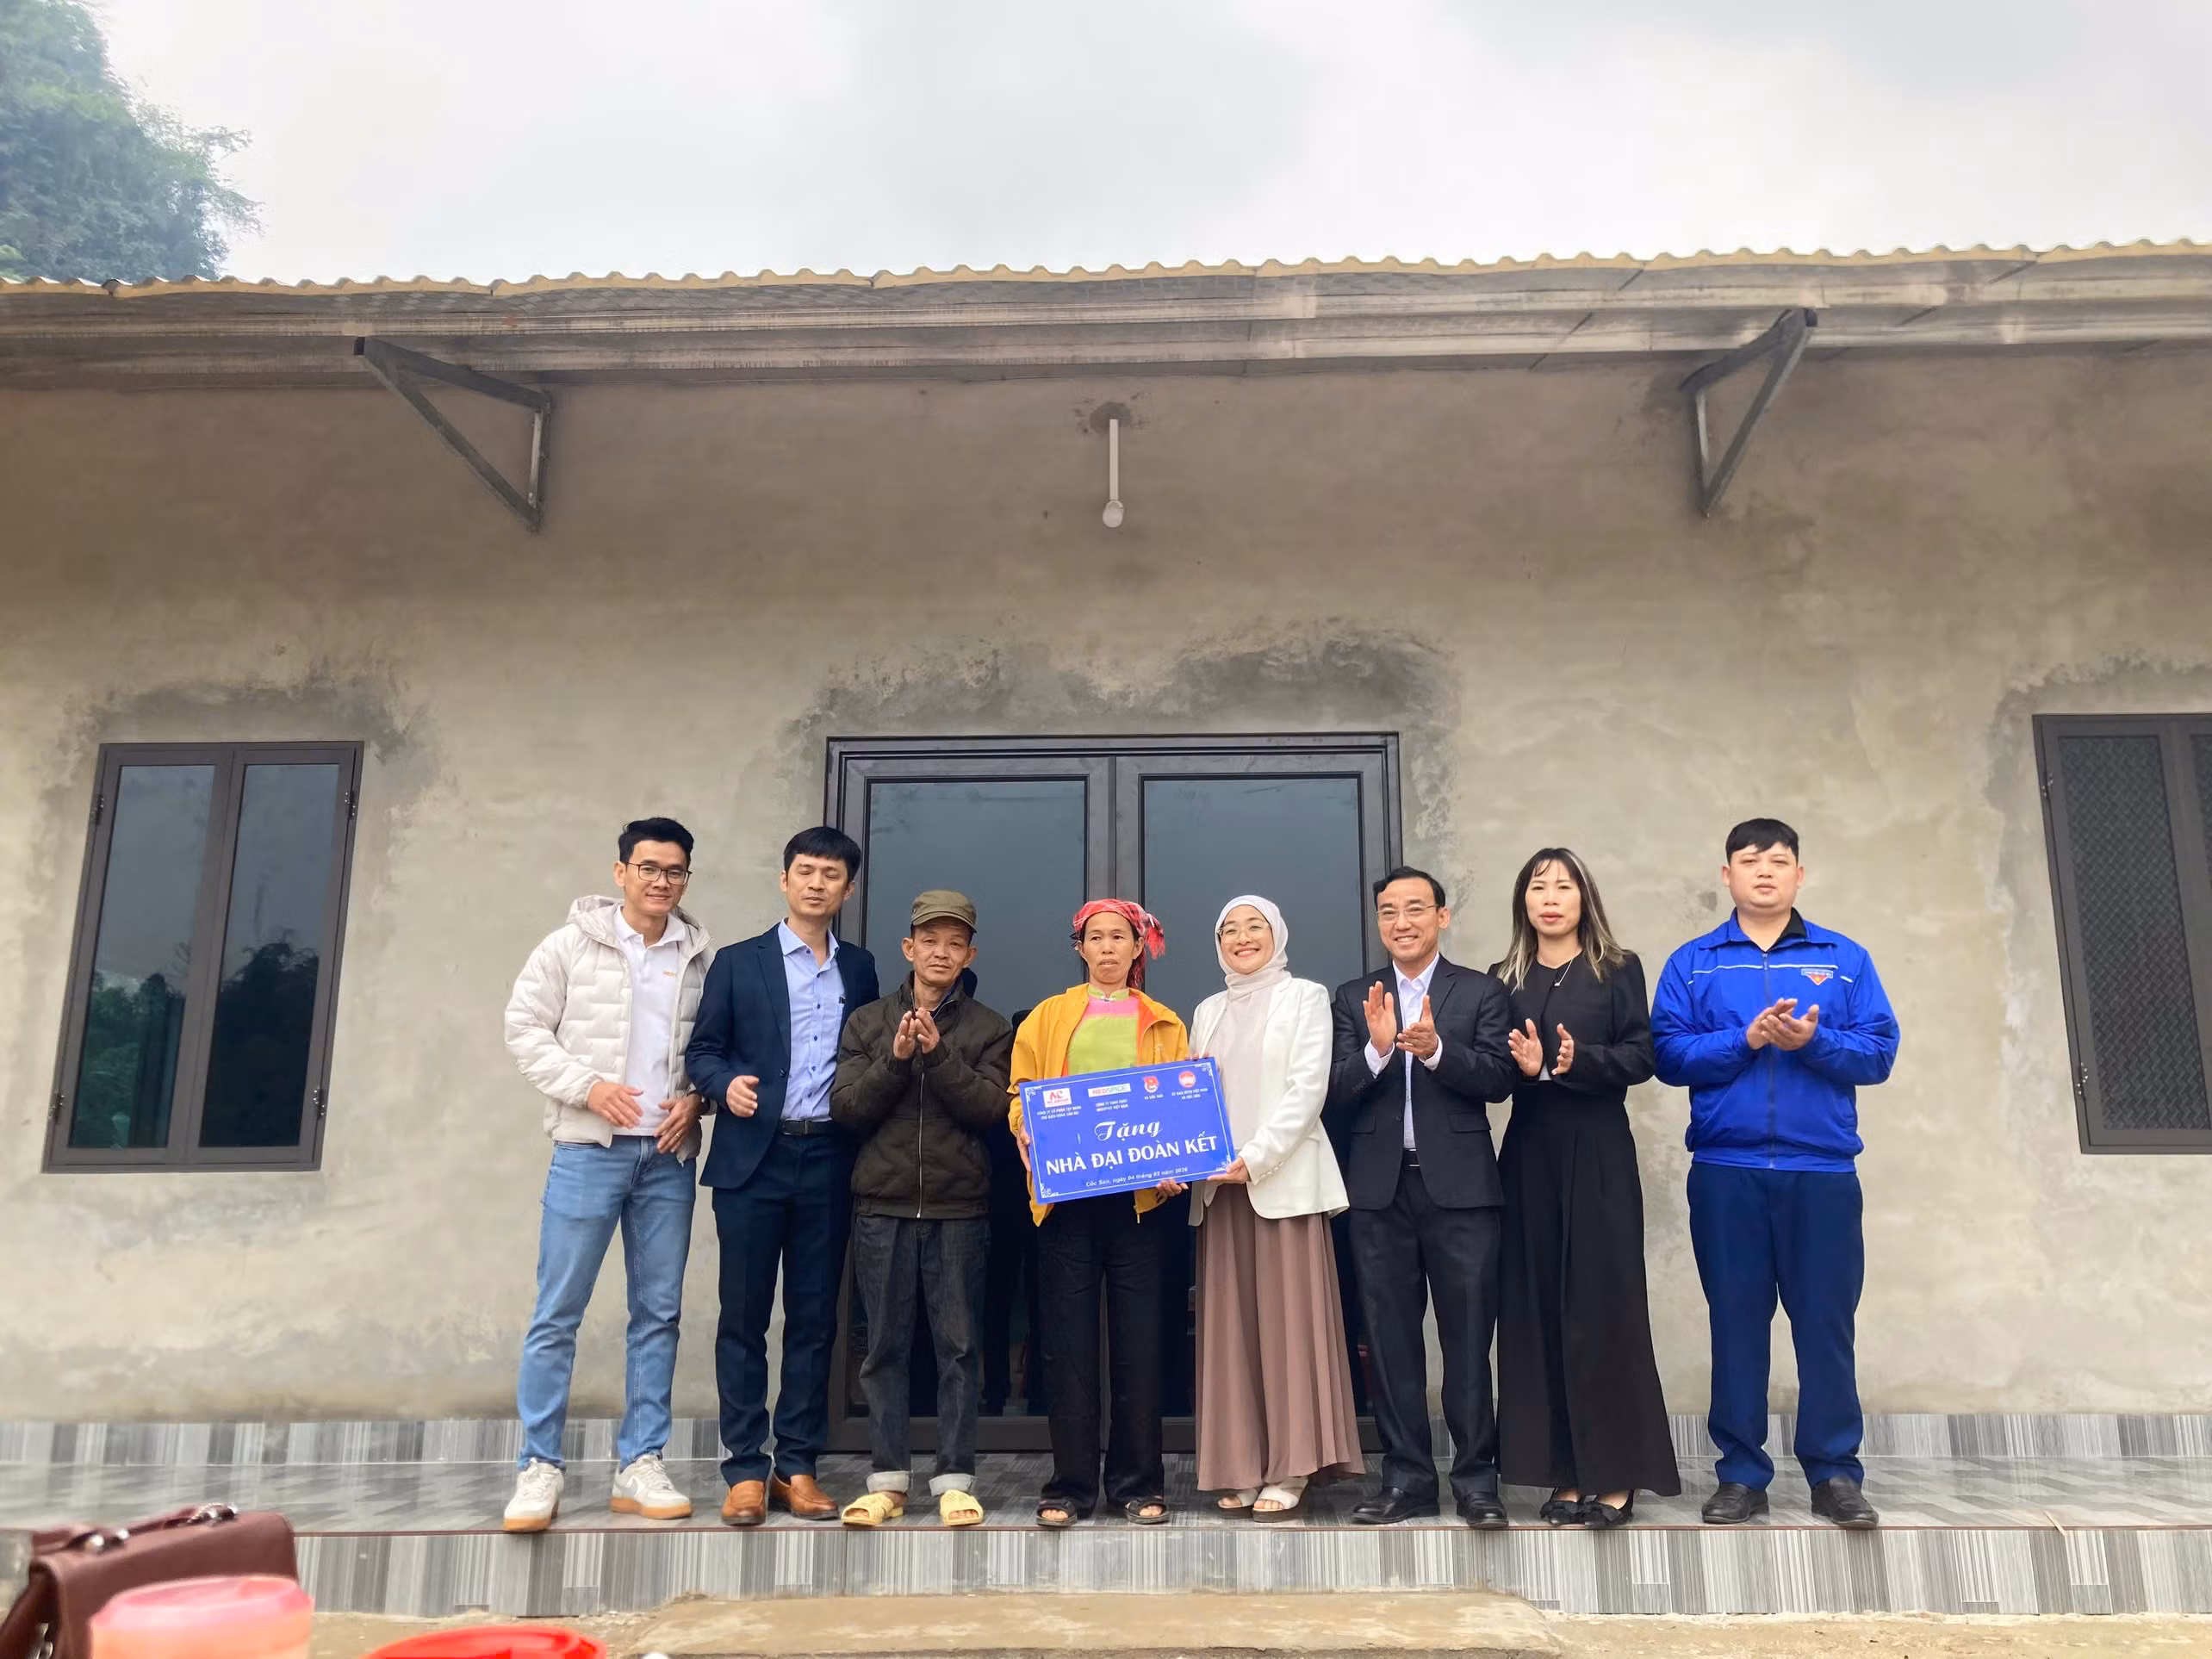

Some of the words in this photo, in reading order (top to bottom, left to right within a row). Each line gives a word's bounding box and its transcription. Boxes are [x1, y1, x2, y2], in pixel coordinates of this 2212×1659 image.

[1094, 1121, 1163, 1141] Tặng
[1046, 1151, 1088, 1176] NHÀ
[1090, 1149, 1123, 1170] ĐẠI
[1128, 1139, 1180, 1163] ĐOÀN
[1184, 1130, 1217, 1154] KẾT
